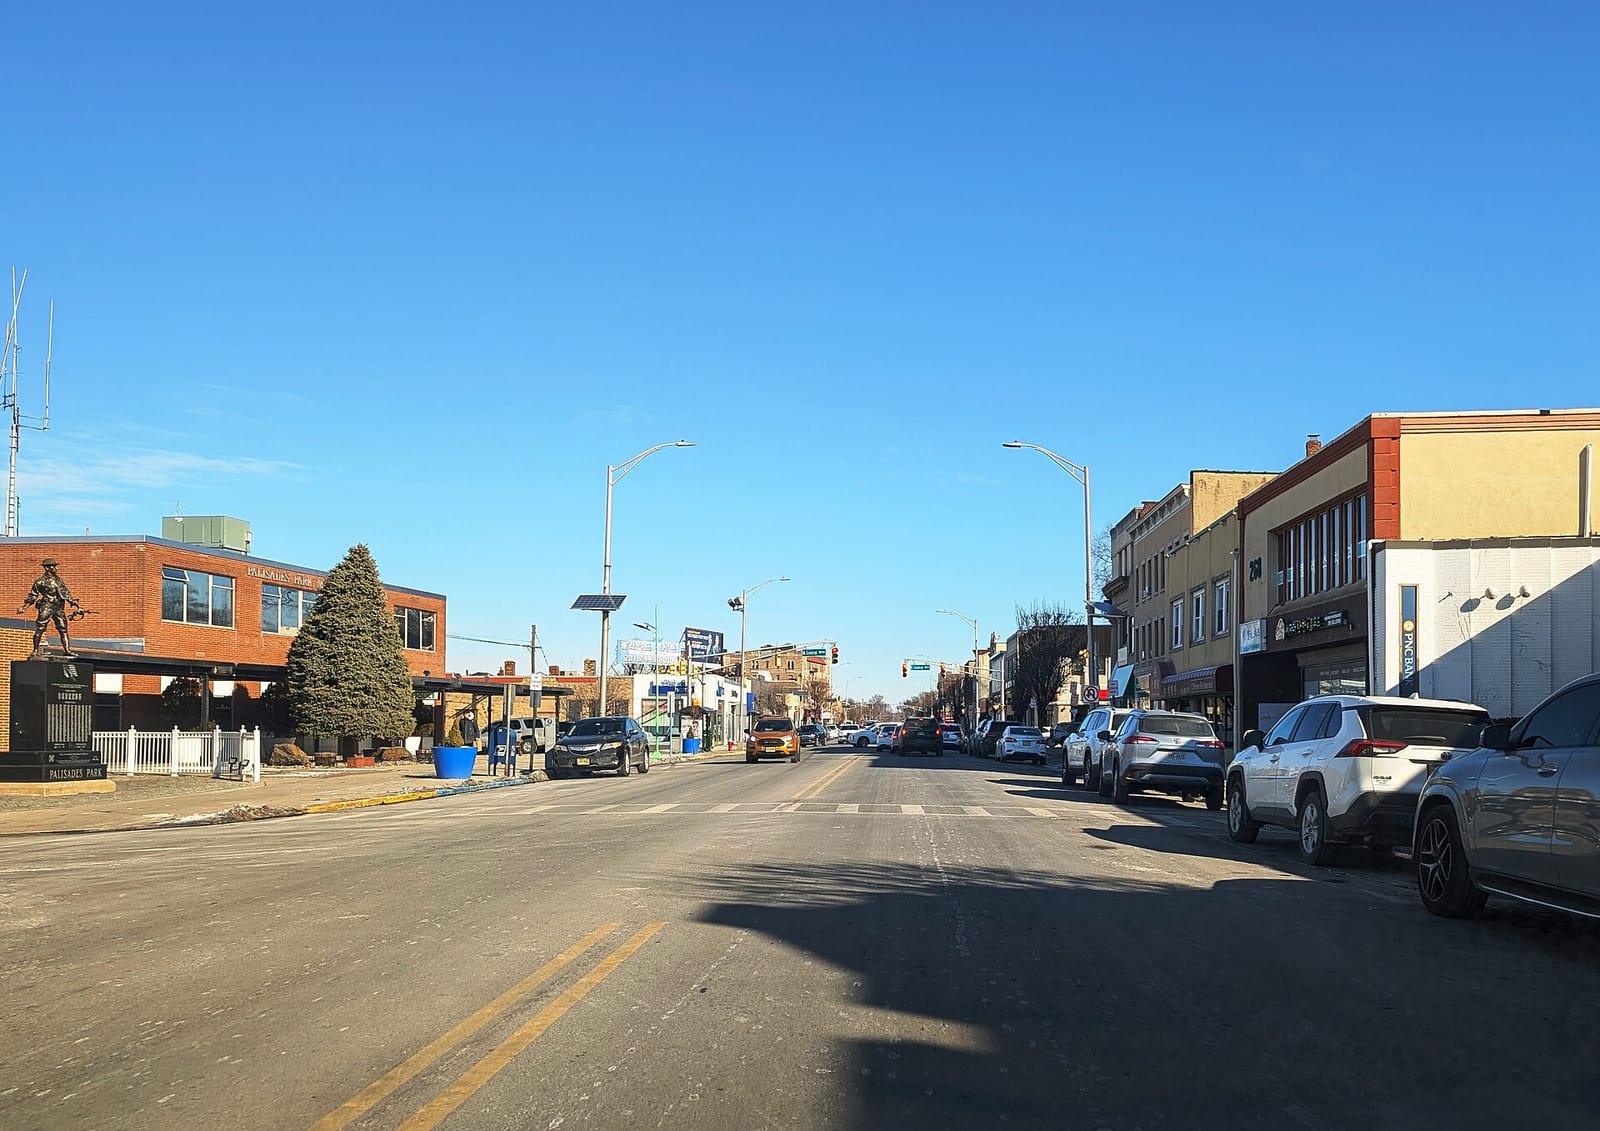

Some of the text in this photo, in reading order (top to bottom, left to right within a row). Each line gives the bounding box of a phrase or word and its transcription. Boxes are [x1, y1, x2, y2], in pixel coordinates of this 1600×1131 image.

[247, 566, 290, 584] PALISADES
[294, 574, 313, 588] PARK
[1403, 633, 1414, 686] PNC BANK
[49, 767, 102, 780] PALISADES PARK
